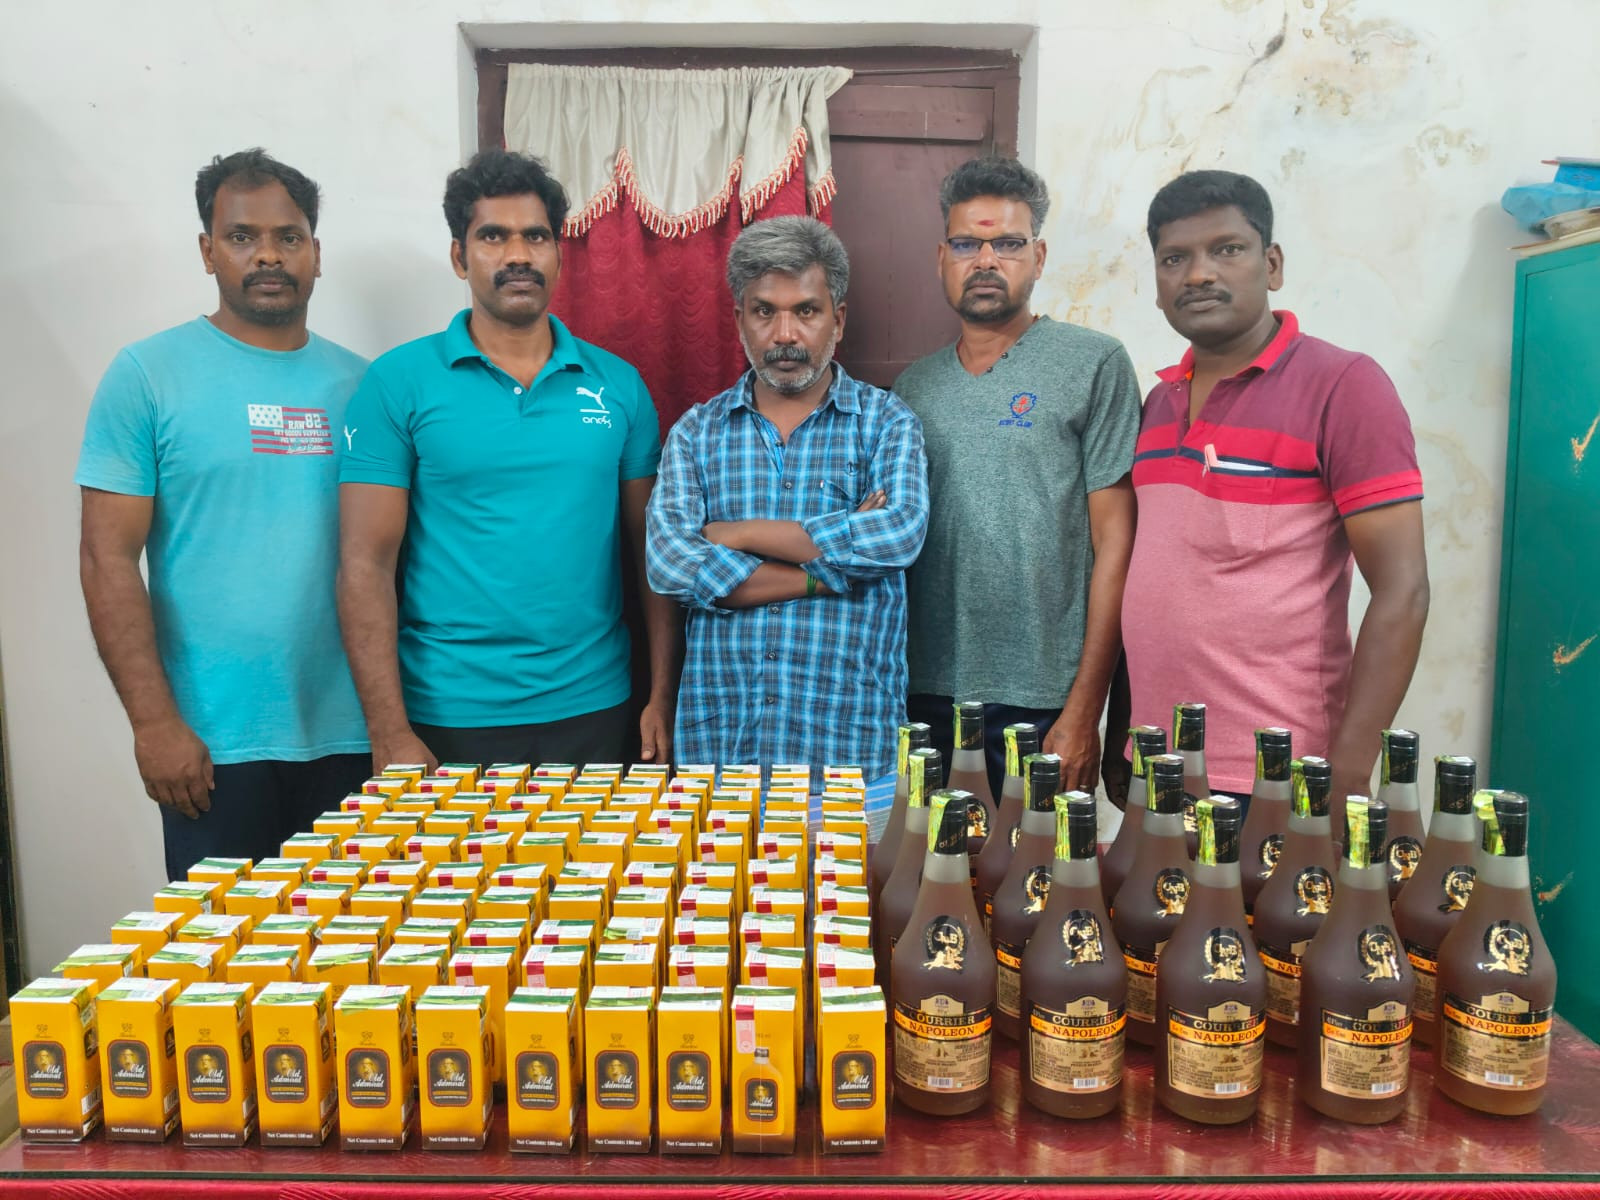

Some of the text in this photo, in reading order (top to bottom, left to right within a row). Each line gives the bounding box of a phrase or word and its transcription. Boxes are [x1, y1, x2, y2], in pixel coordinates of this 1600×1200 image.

[304, 412, 322, 429] 82
[909, 1021, 975, 1037] NAPOLEON
[1053, 1023, 1118, 1038] NAPOLEON
[1466, 1016, 1538, 1035] NAPOLEON
[1194, 1029, 1259, 1043] NAPOLEON
[1352, 1026, 1411, 1043] NAPOLEON
